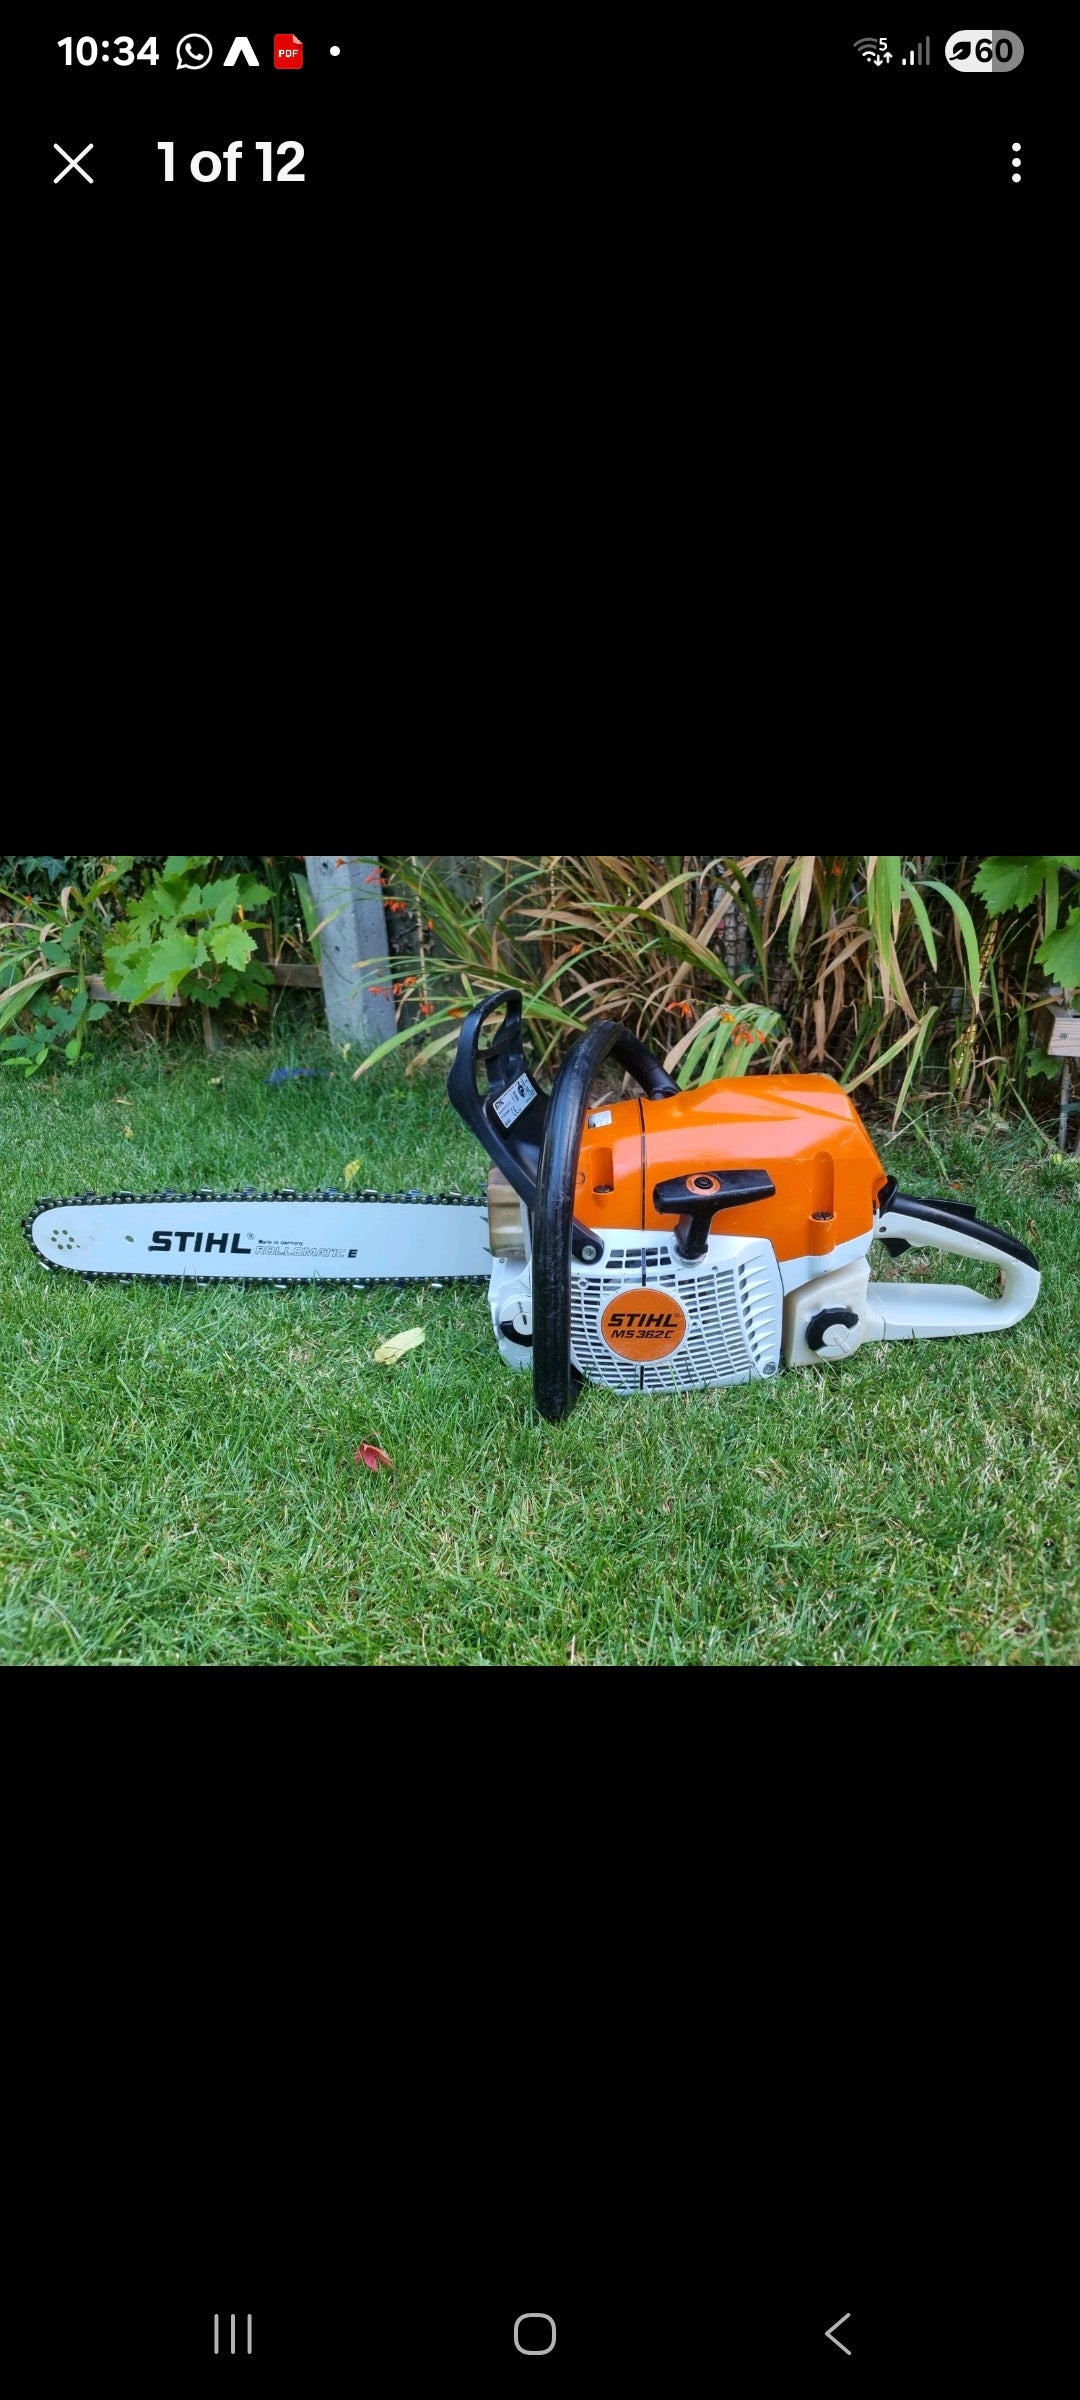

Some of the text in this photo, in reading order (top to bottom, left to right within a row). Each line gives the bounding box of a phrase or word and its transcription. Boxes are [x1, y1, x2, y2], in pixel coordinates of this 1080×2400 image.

[148, 1230, 252, 1254] STIHL
[255, 1245, 359, 1259] ROLLOMATIC E
[607, 1313, 678, 1328] STIHL
[611, 1329, 635, 1339] MS
